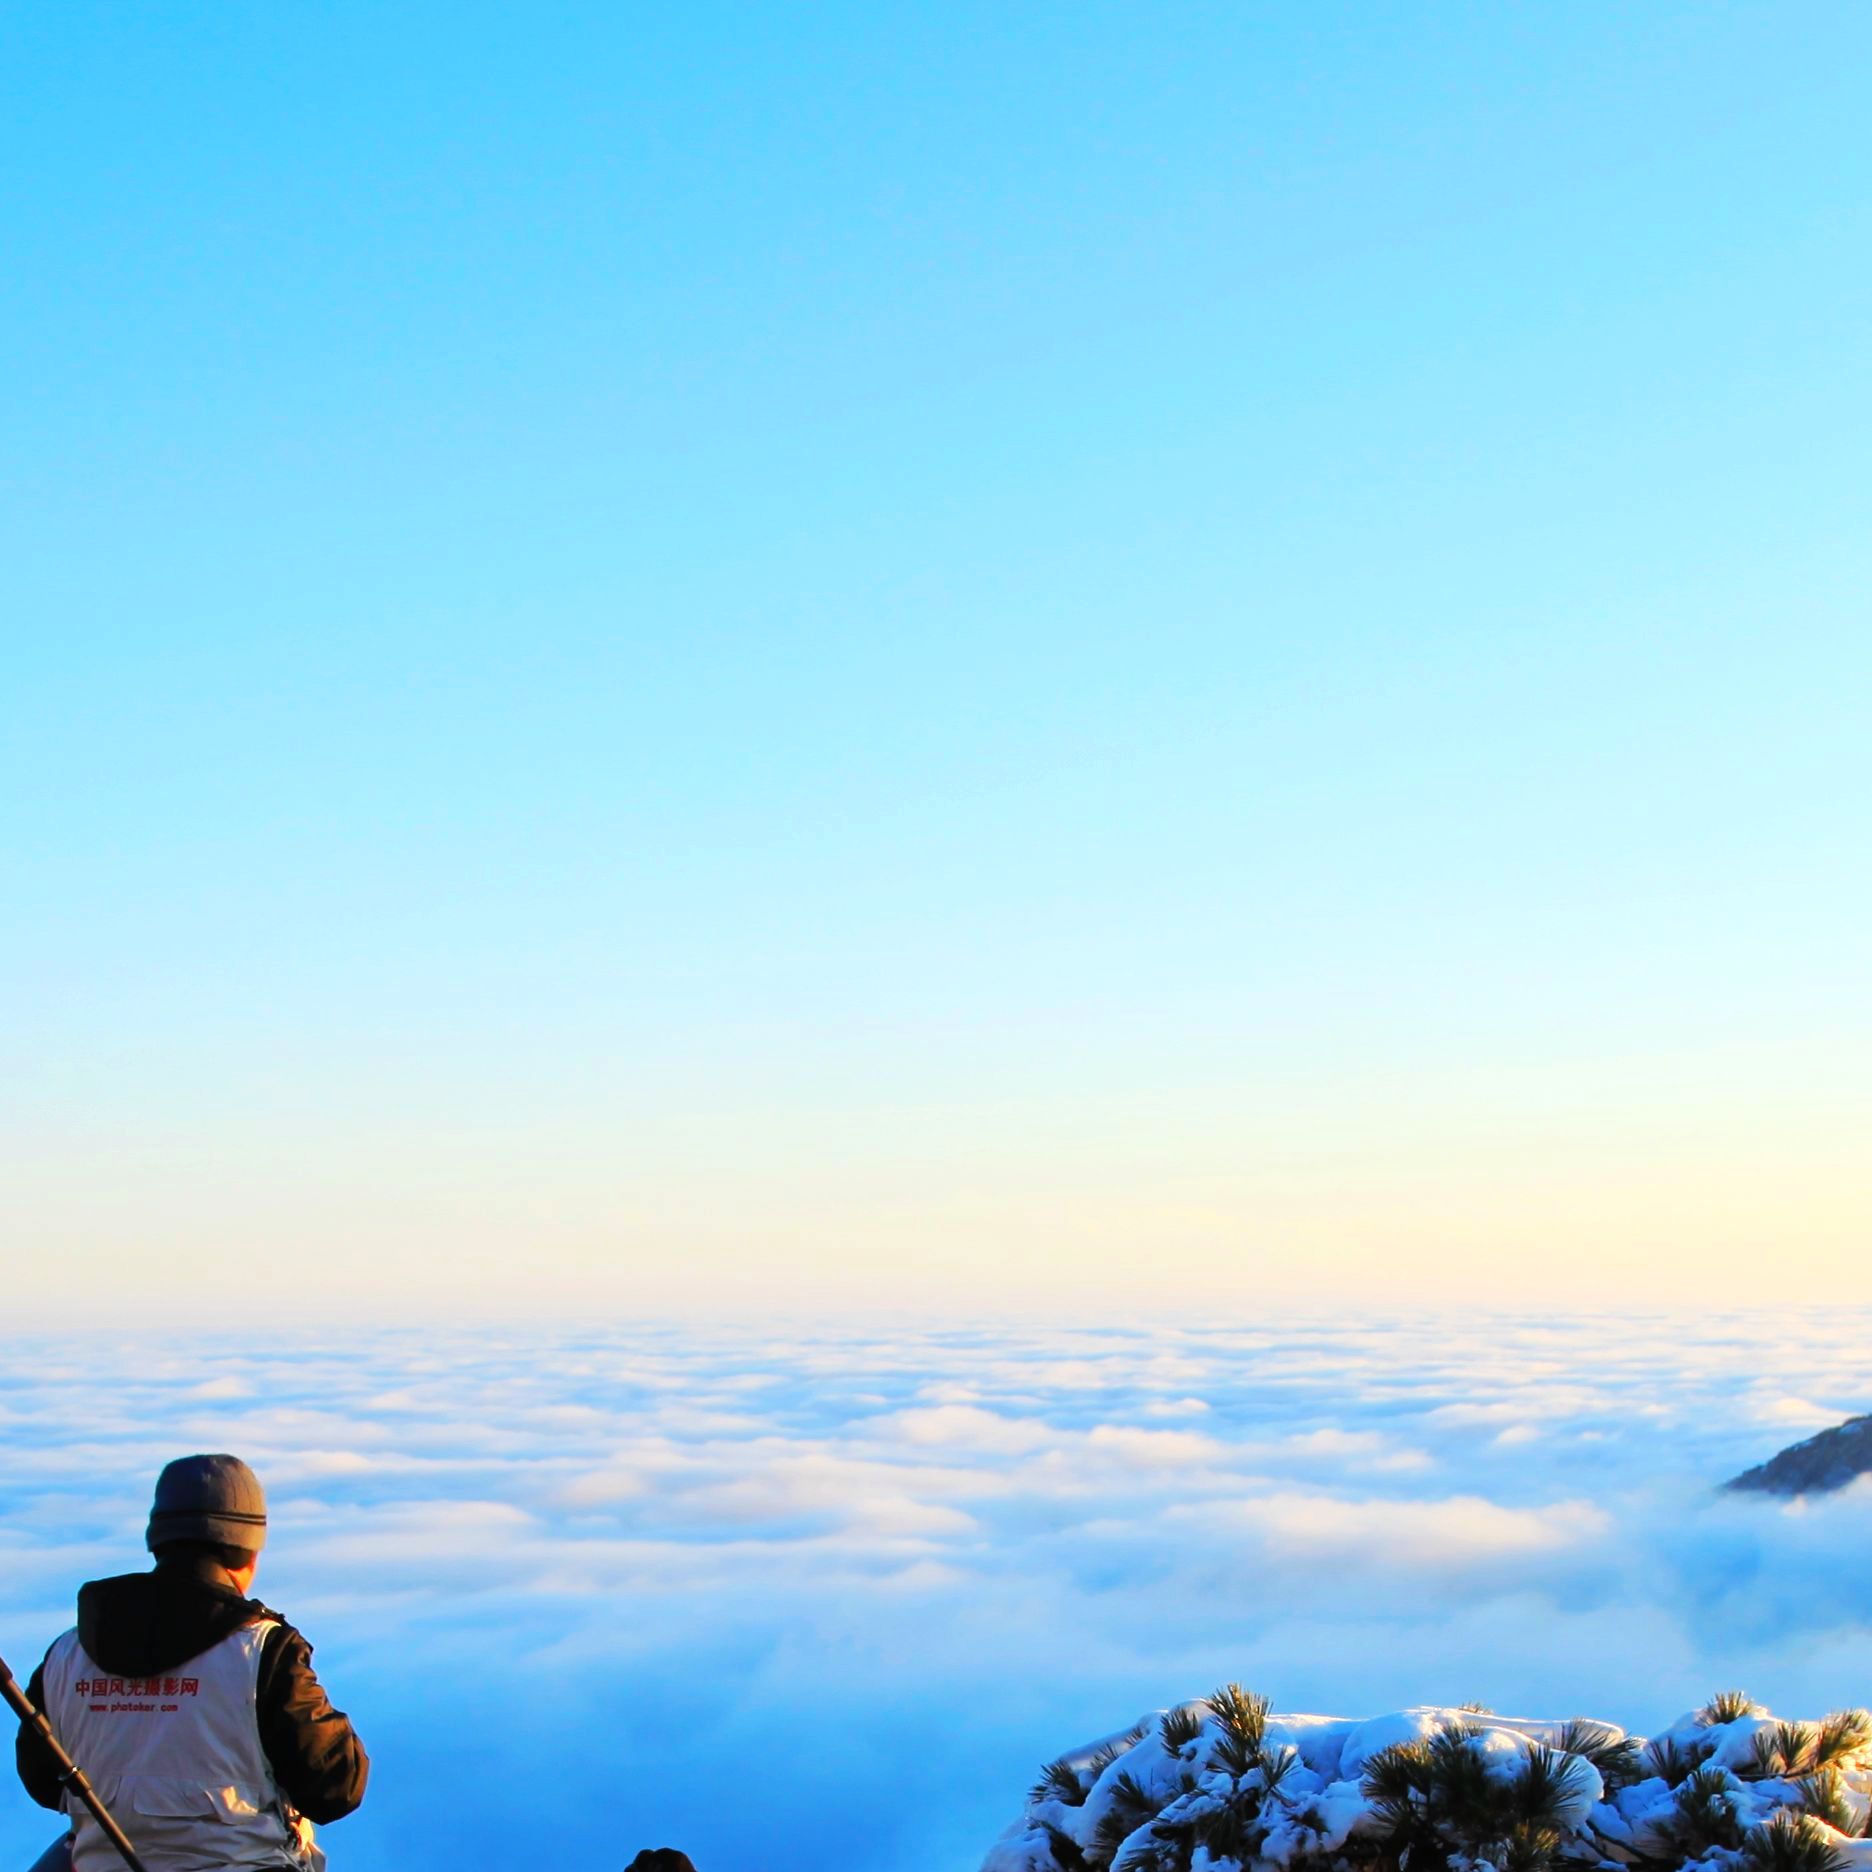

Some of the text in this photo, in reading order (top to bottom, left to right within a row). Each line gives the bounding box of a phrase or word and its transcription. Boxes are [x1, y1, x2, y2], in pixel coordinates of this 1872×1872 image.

[75, 1677, 199, 1697] 中国风光摄影网
